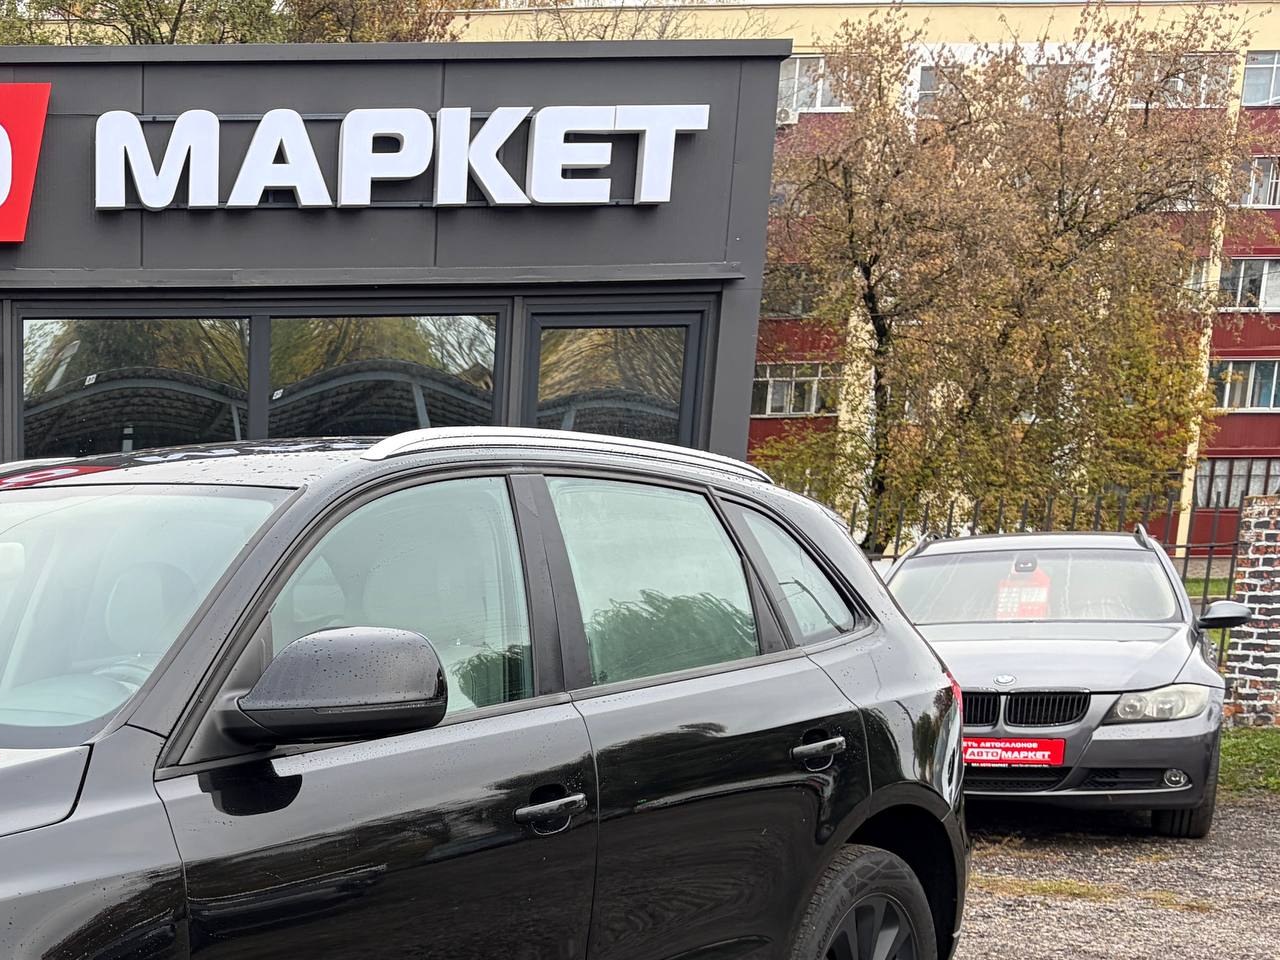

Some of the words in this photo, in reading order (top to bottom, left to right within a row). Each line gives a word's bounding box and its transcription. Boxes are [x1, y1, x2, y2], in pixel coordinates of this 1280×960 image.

[94, 104, 710, 211] МАРКЕТ
[968, 750, 999, 758] АВТО
[1001, 751, 1051, 759] МАРКЕТ
